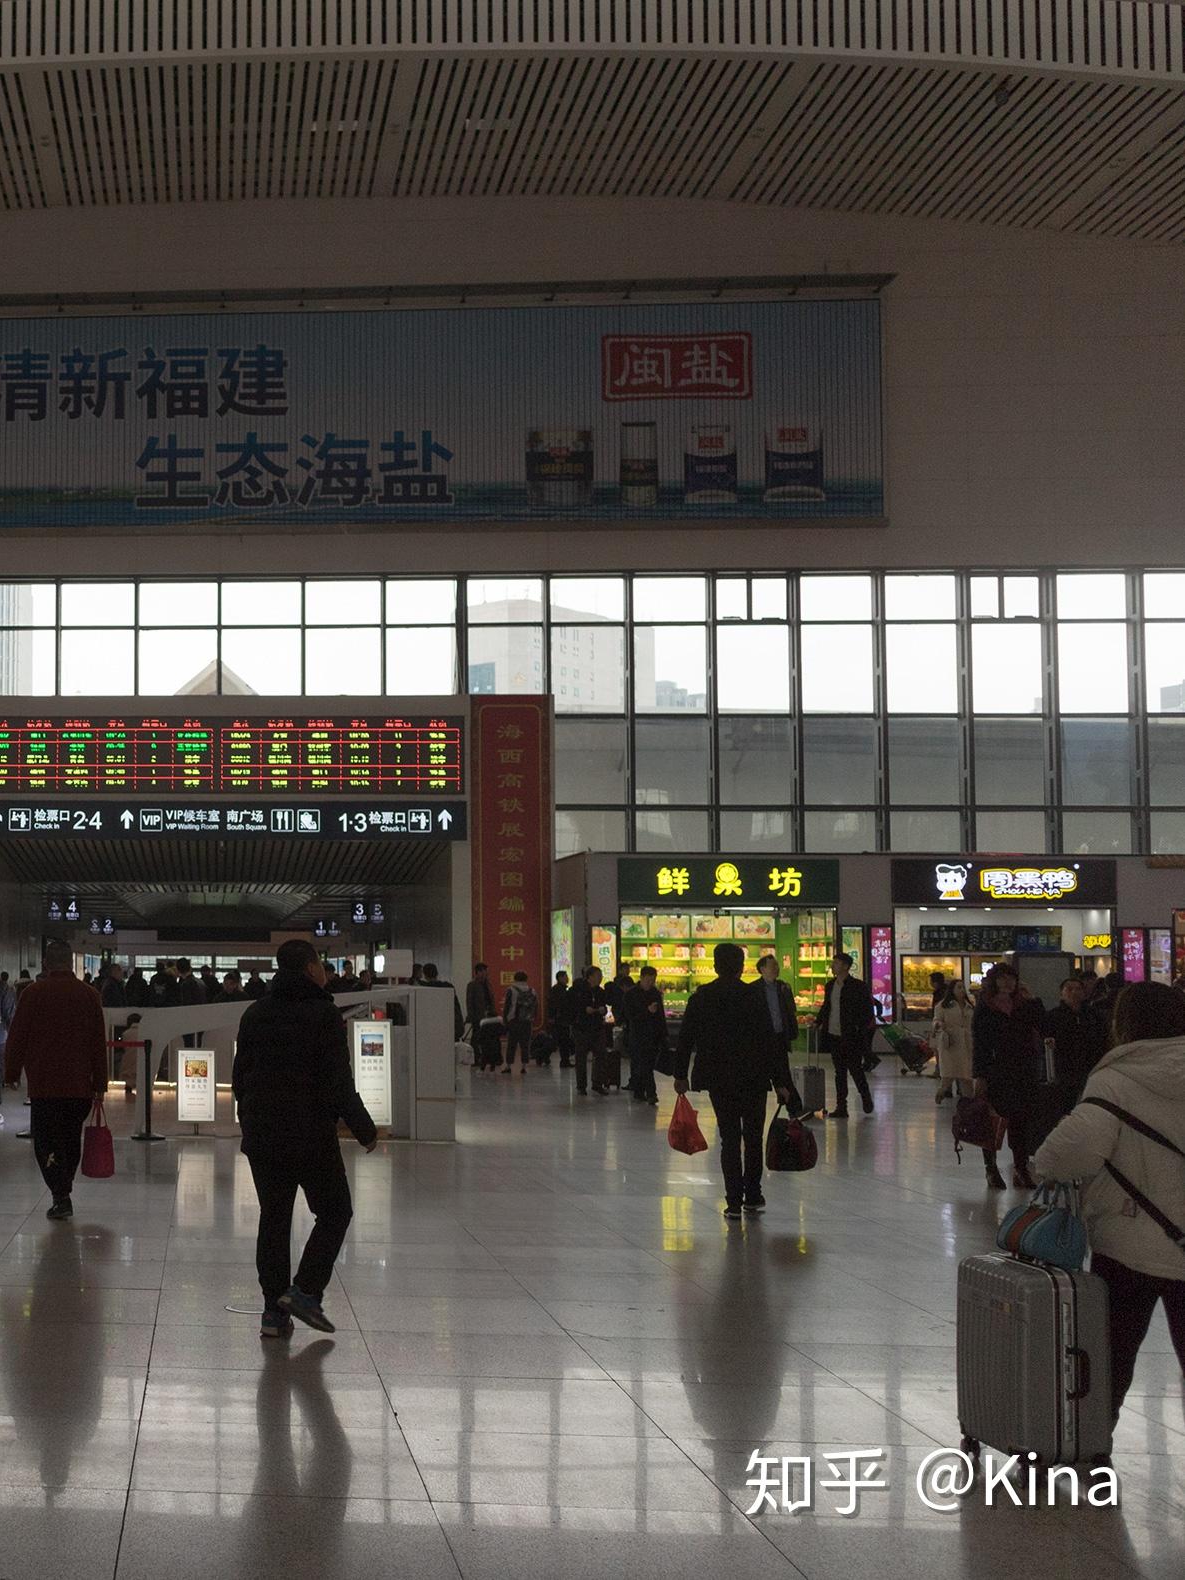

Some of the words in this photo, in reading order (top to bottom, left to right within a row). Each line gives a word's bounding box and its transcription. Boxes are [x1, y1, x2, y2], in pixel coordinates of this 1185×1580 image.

[612, 342, 739, 388] 闽盐
[135, 431, 455, 511] 生态海盐
[34, 808, 70, 822] 检票口
[142, 815, 160, 826] VIP
[166, 809, 220, 823] VIP候车室
[226, 810, 264, 823] 南广场
[369, 811, 406, 825] 检票口
[656, 862, 802, 897] 鲜果坊
[983, 871, 1077, 889] 周黑鸭
[68, 901, 77, 912] 4
[356, 903, 364, 915] 3
[105, 919, 112, 927] 2
